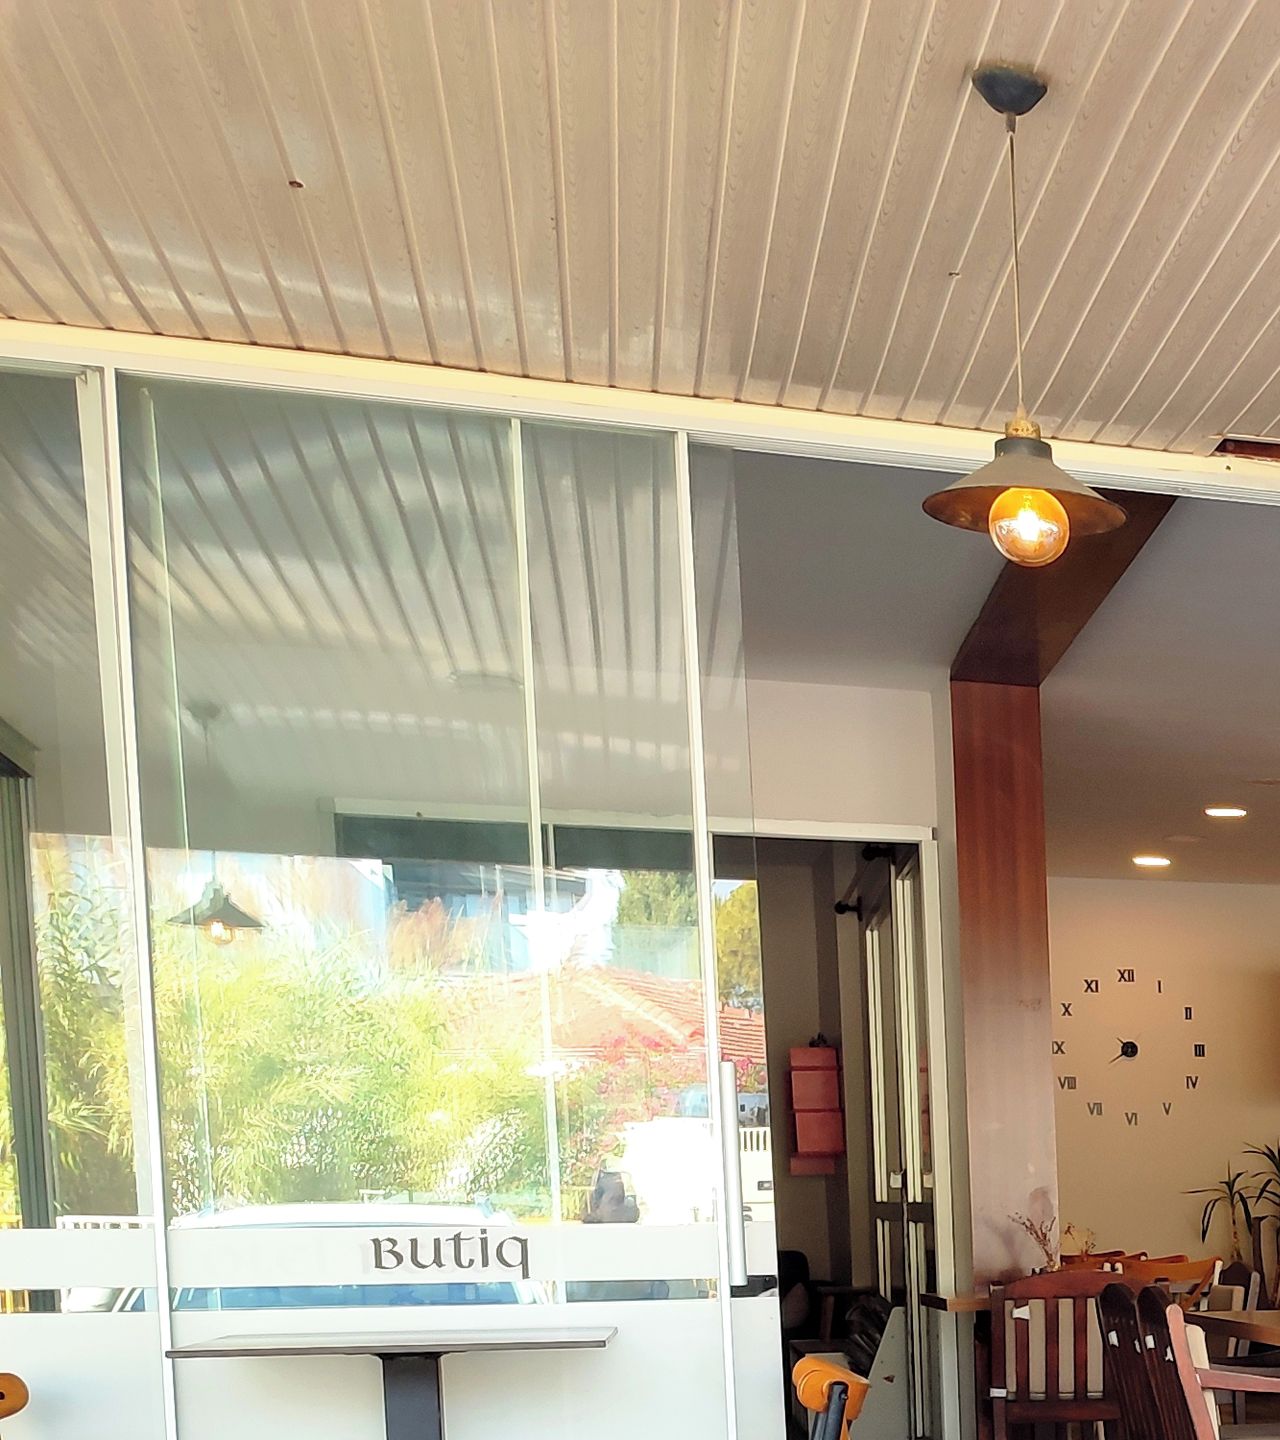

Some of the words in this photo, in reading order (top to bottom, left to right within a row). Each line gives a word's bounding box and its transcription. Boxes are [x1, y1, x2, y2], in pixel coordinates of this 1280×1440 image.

[1117, 969, 1135, 982] XII
[1083, 980, 1099, 992] XI
[1061, 1003, 1072, 1016] X
[1184, 1007, 1193, 1020] II
[1051, 1041, 1066, 1054] IX
[1193, 1044, 1205, 1057] III
[1057, 1077, 1077, 1089] VIII
[1185, 1076, 1199, 1089] IV
[1087, 1103, 1103, 1115] VII
[1162, 1103, 1172, 1115] V
[1124, 1113, 1138, 1126] VI
[369, 1228, 531, 1280] Butiq
